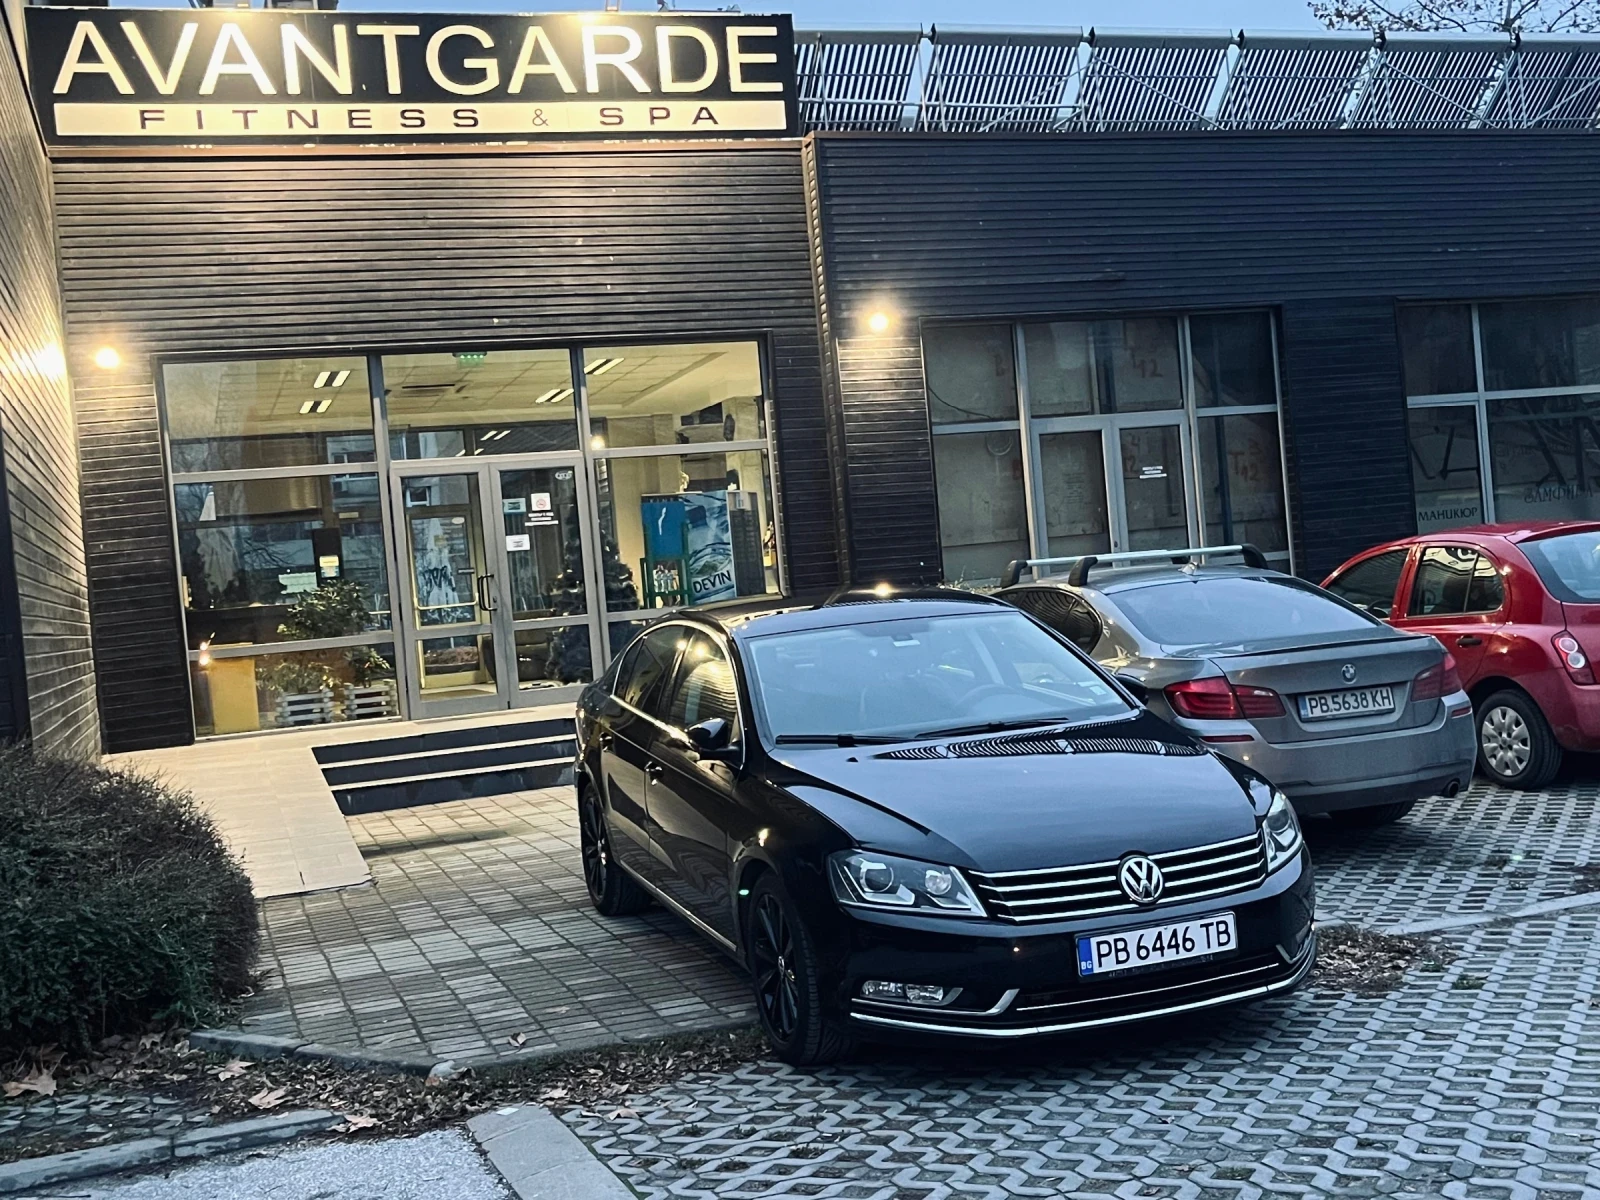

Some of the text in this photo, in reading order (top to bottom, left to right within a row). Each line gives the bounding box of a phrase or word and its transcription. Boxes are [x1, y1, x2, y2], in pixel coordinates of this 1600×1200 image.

[53, 21, 784, 95] AVANTGARDE
[138, 106, 719, 129] FITNESS & SPA
[1418, 507, 1478, 521] МАНИКЮР
[693, 570, 732, 593] DEVIN
[1307, 696, 1330, 715] PB
[1331, 691, 1369, 712] 5638
[1370, 688, 1392, 707] KH
[1096, 937, 1130, 968] PB
[1136, 926, 1195, 961] 6446
[1200, 919, 1231, 949] TB
[1080, 961, 1093, 970] BG
